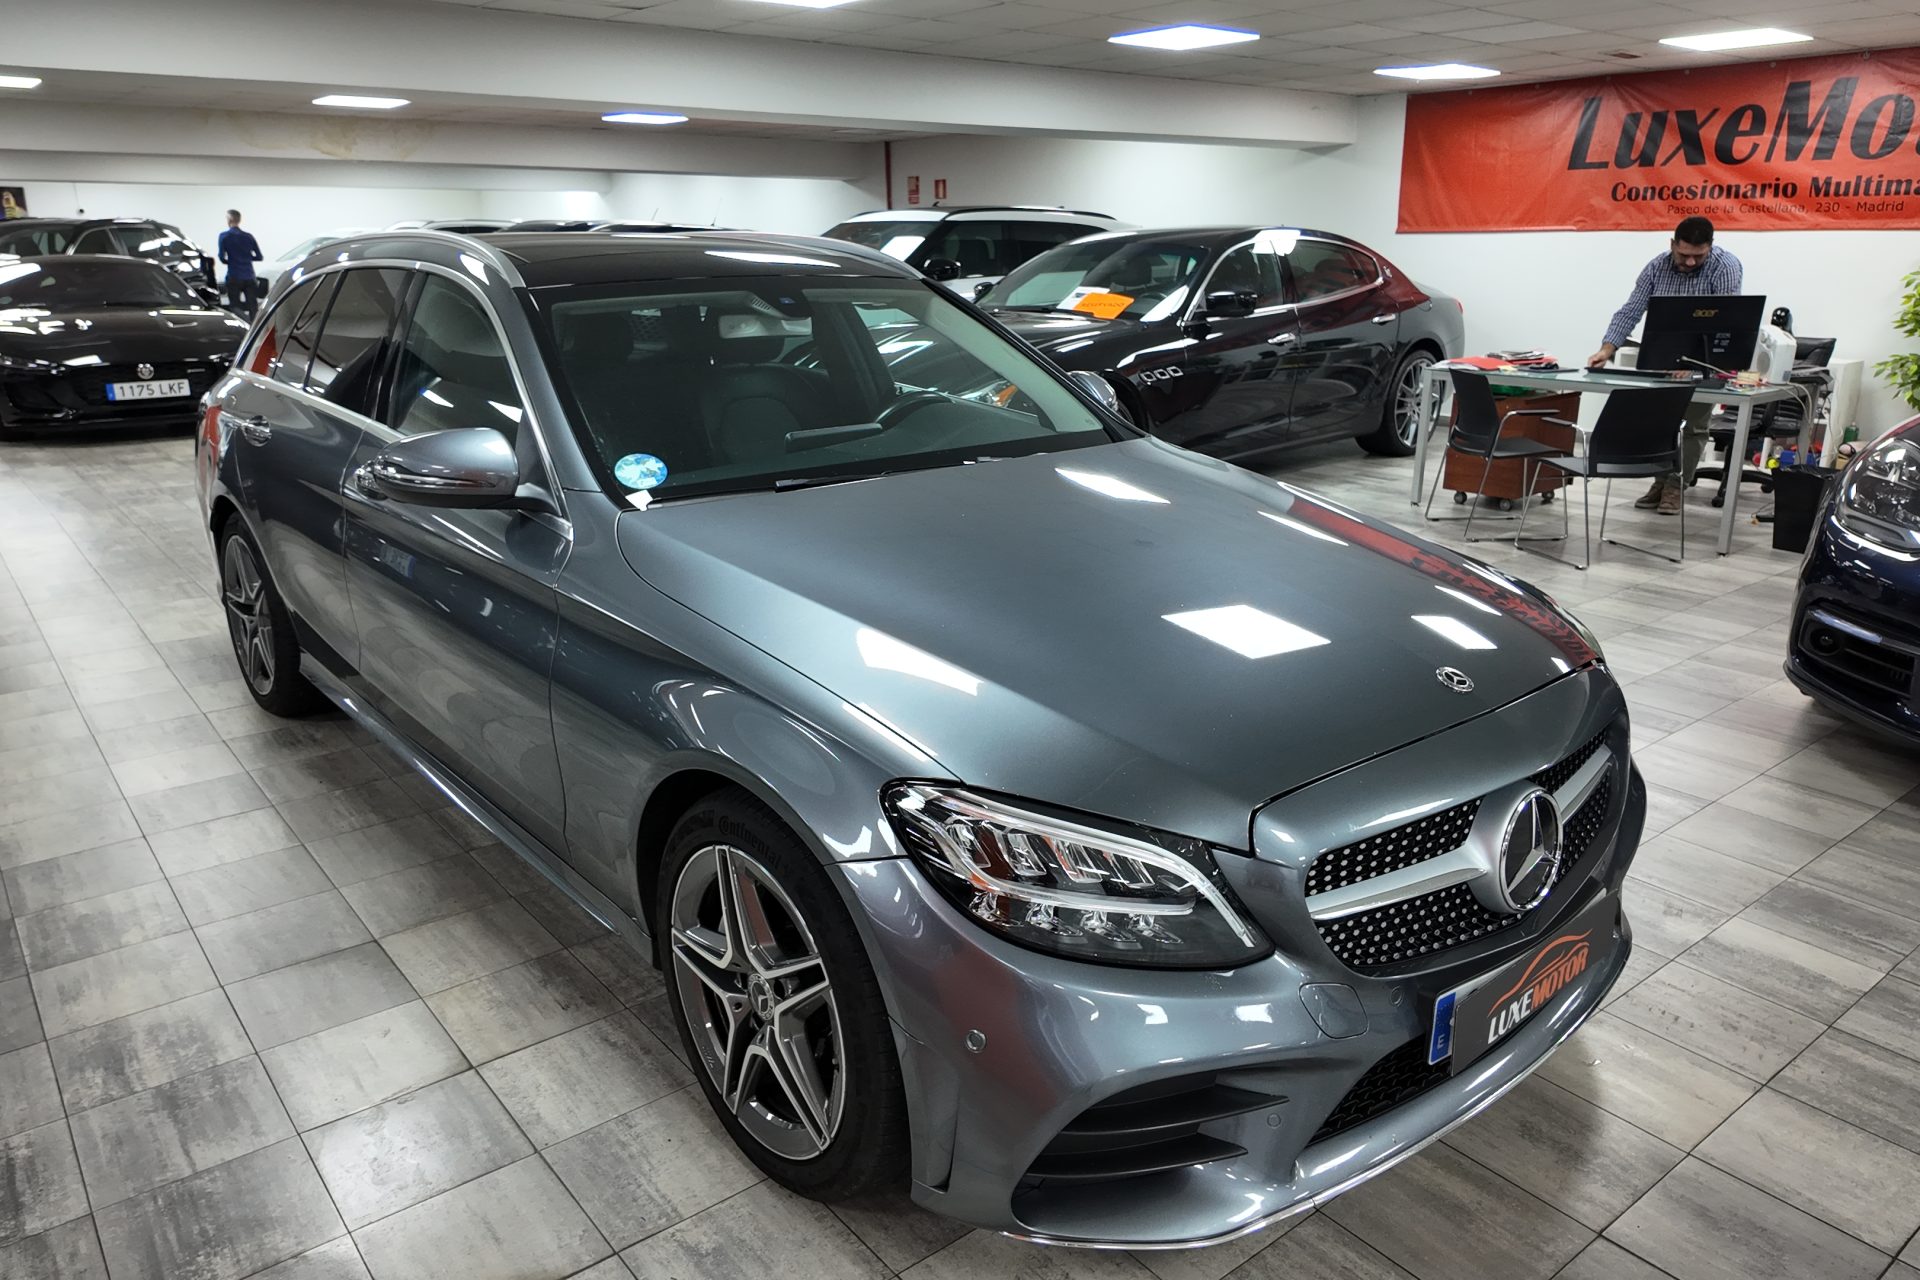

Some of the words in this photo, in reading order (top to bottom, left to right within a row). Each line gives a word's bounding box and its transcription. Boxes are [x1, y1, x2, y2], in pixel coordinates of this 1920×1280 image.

[1567, 77, 1920, 171] LuxeMo
[1611, 177, 1798, 202] Concesionario
[1667, 204, 1700, 215] Paseo
[1704, 204, 1719, 214] de
[1723, 203, 1734, 214] la
[1739, 201, 1809, 215] Castellana,
[1815, 201, 1840, 213] 230
[1856, 200, 1905, 213] Madrid
[1692, 309, 1719, 318] acer
[119, 383, 156, 398] 1175
[159, 381, 186, 396] LKF
[718, 815, 783, 871] Continental
[1437, 1034, 1446, 1050] E
